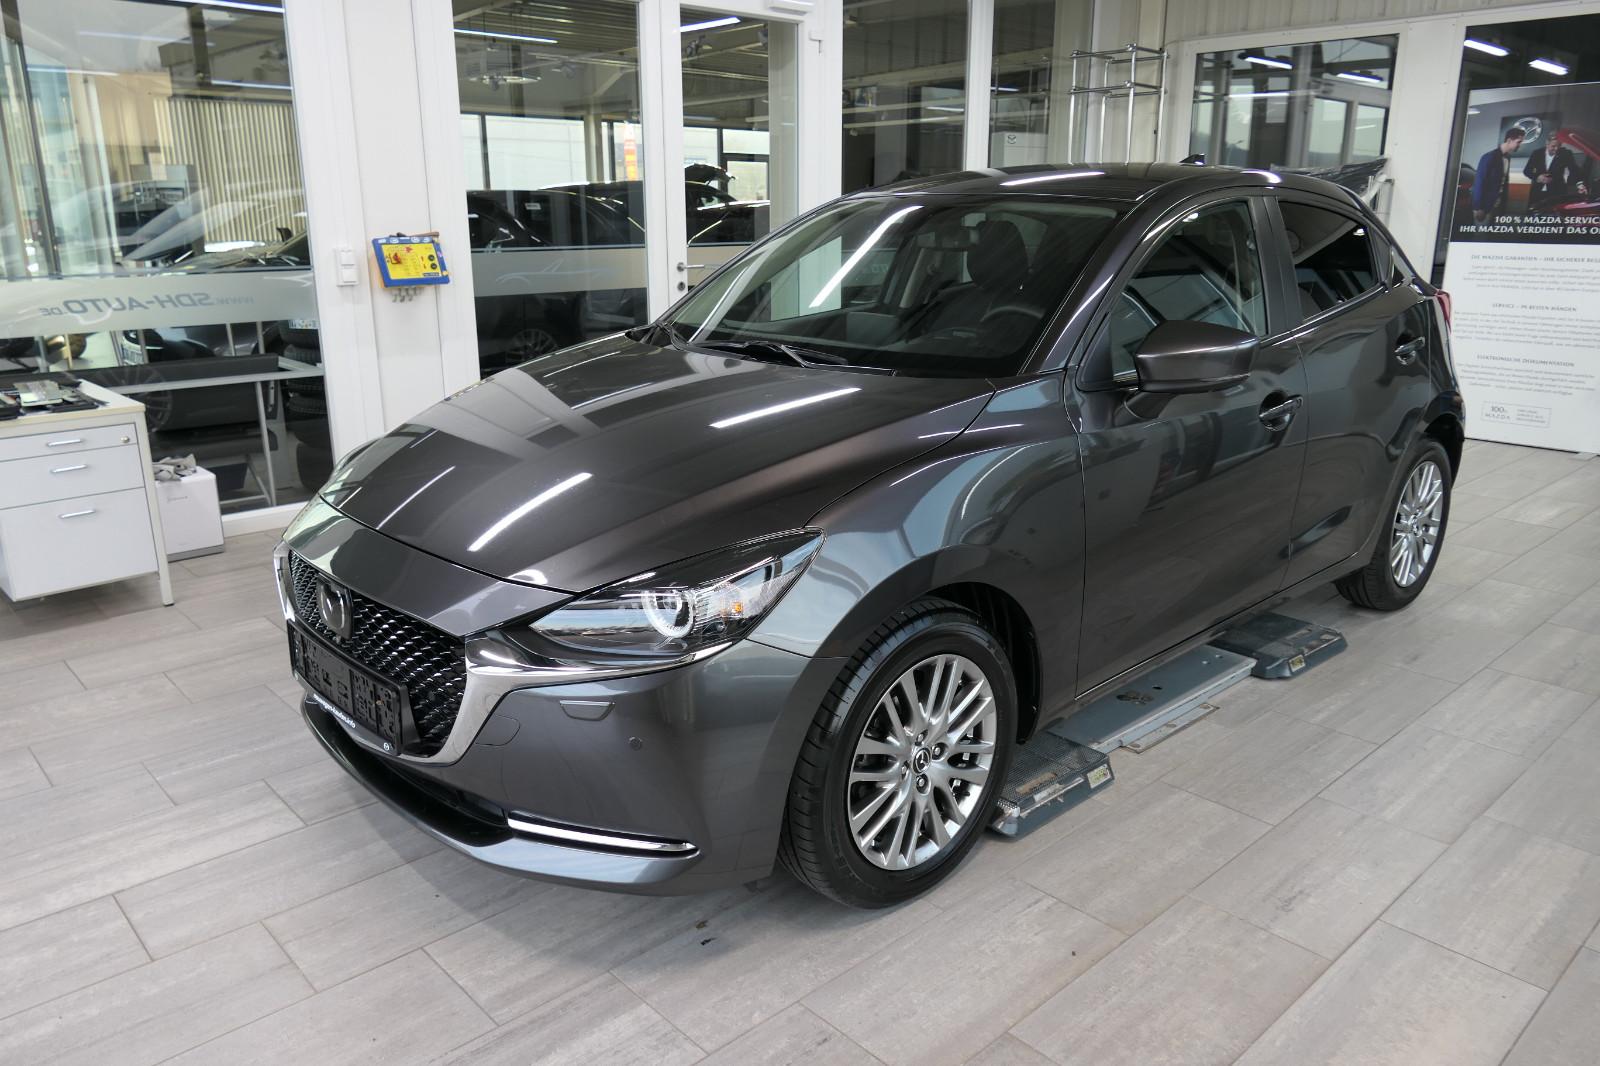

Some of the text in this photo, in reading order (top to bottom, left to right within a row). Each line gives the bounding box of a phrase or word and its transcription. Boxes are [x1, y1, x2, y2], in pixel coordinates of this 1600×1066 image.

[1495, 215, 1513, 224] 100
[1524, 215, 1562, 224] MAZDA
[1460, 225, 1600, 235] IHR MAZDA VERDIENT DAS O
